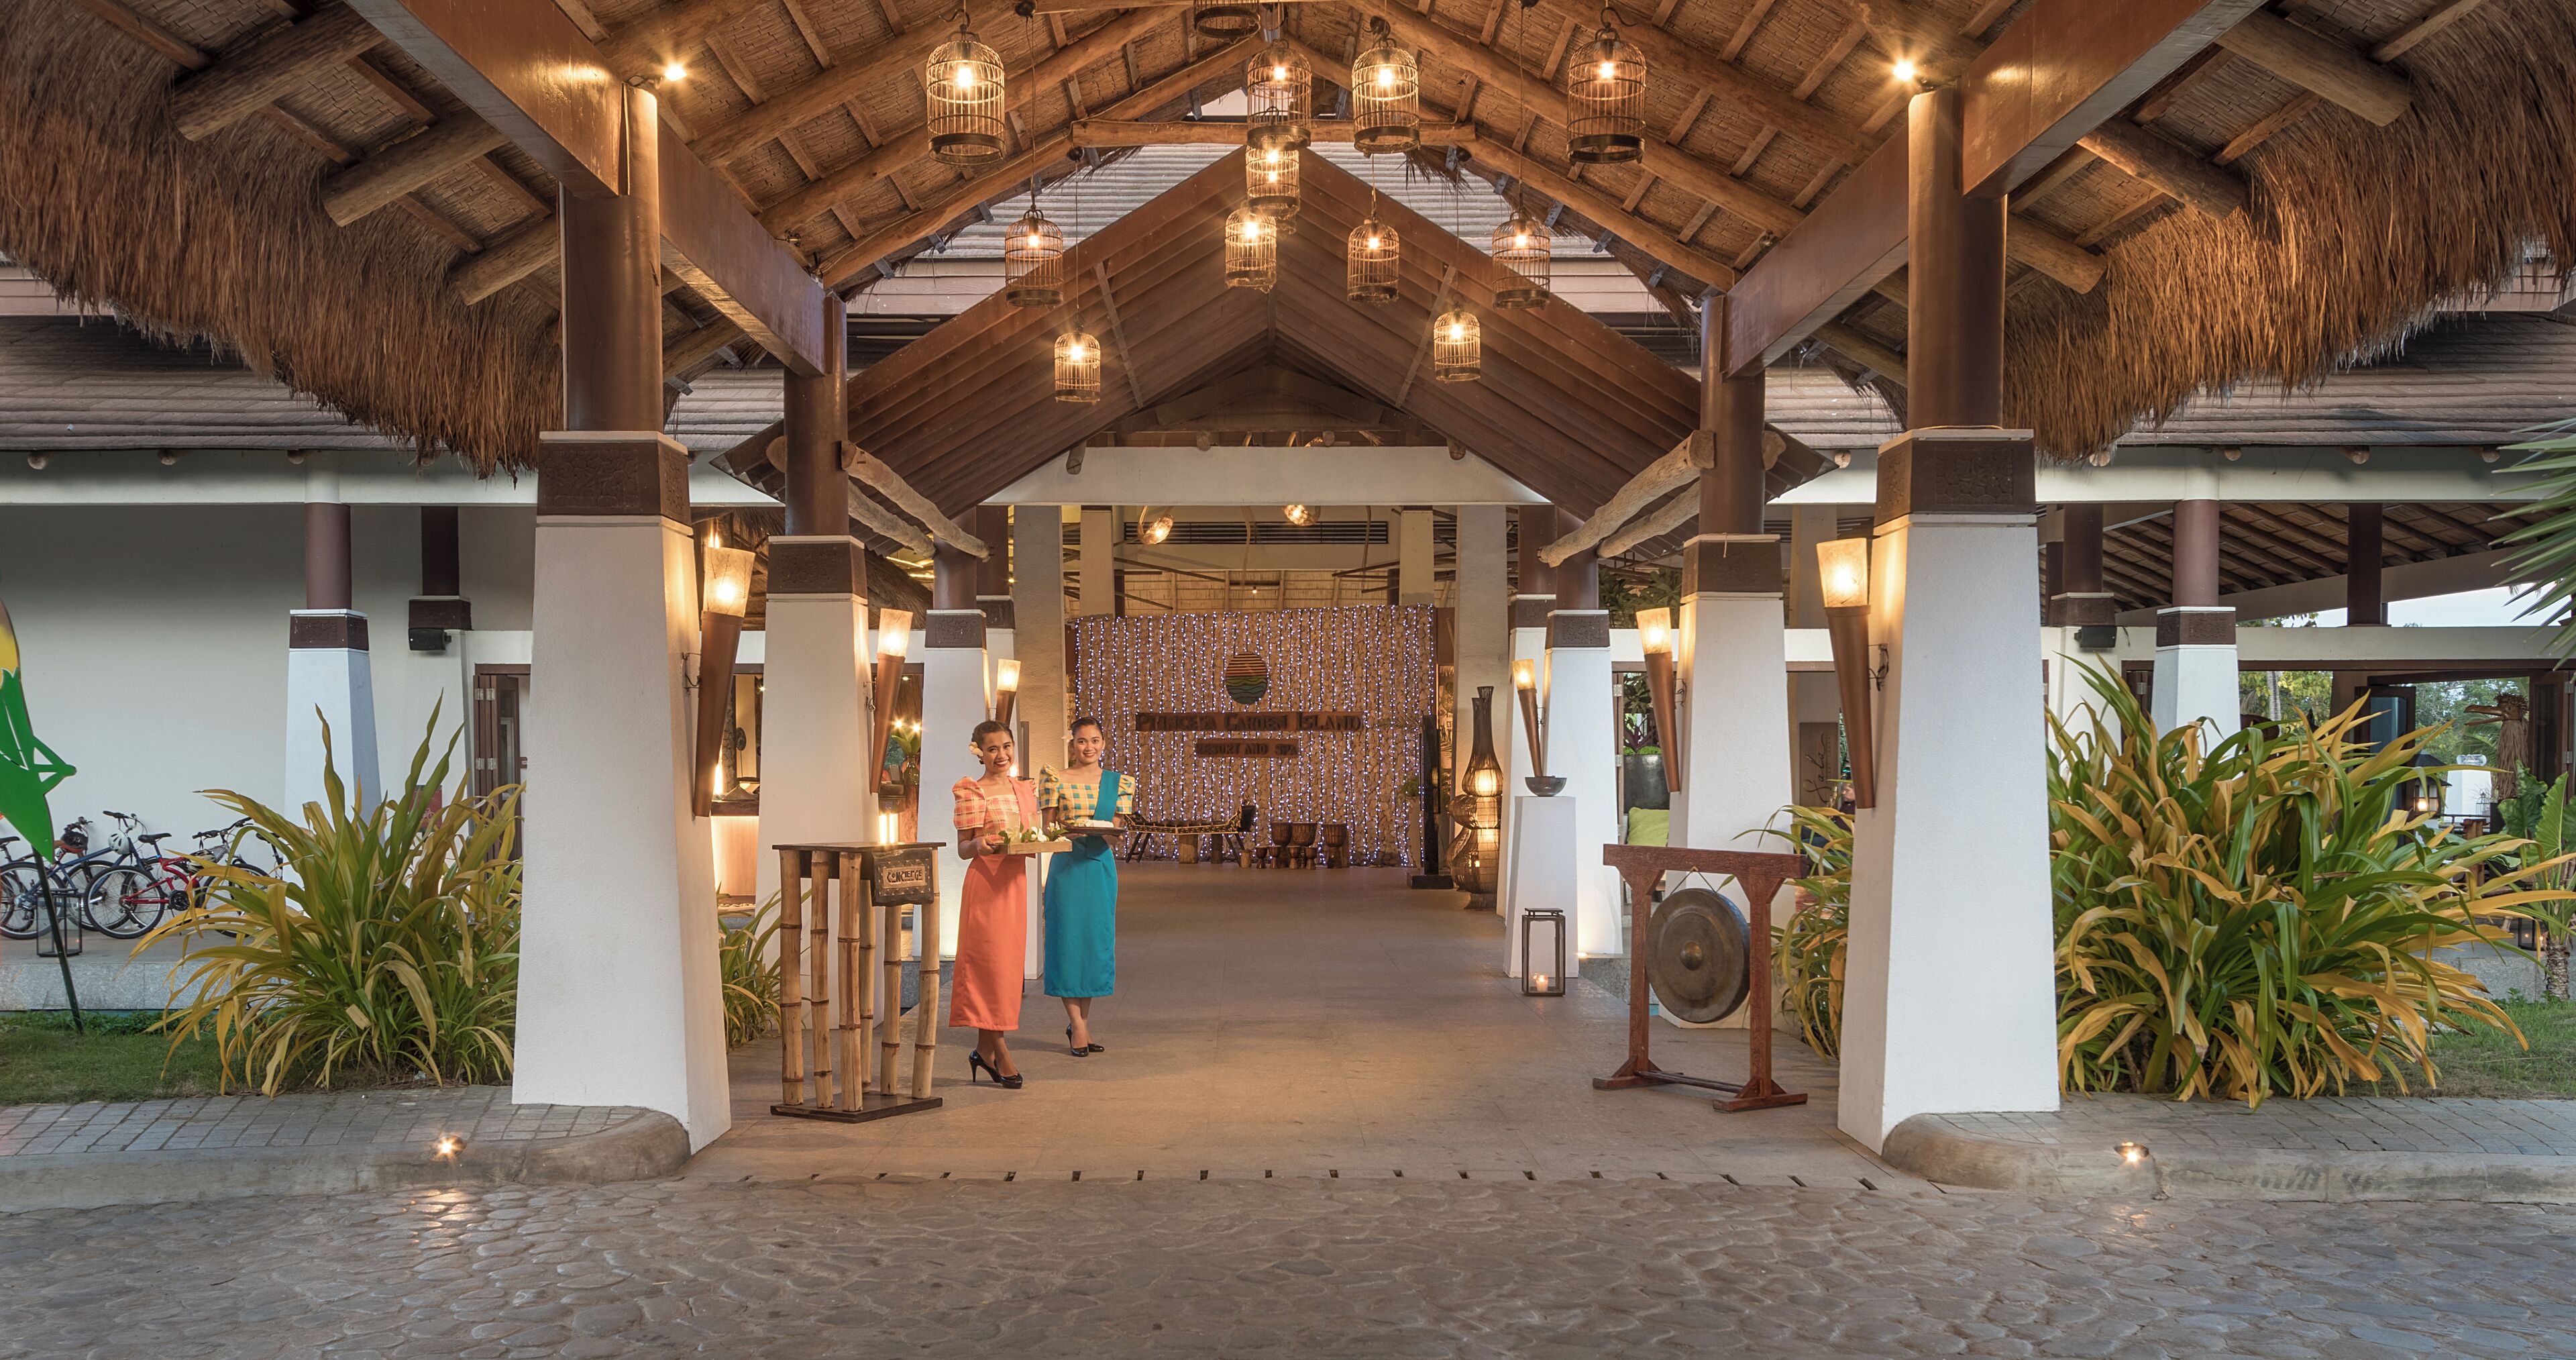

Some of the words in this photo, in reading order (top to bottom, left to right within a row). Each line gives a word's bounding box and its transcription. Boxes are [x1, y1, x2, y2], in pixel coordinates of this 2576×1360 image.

[1297, 711, 1361, 731] ISLAND
[1244, 743, 1270, 755] AND
[1275, 743, 1298, 755] SPA
[886, 870, 922, 883] CONCIERGE
